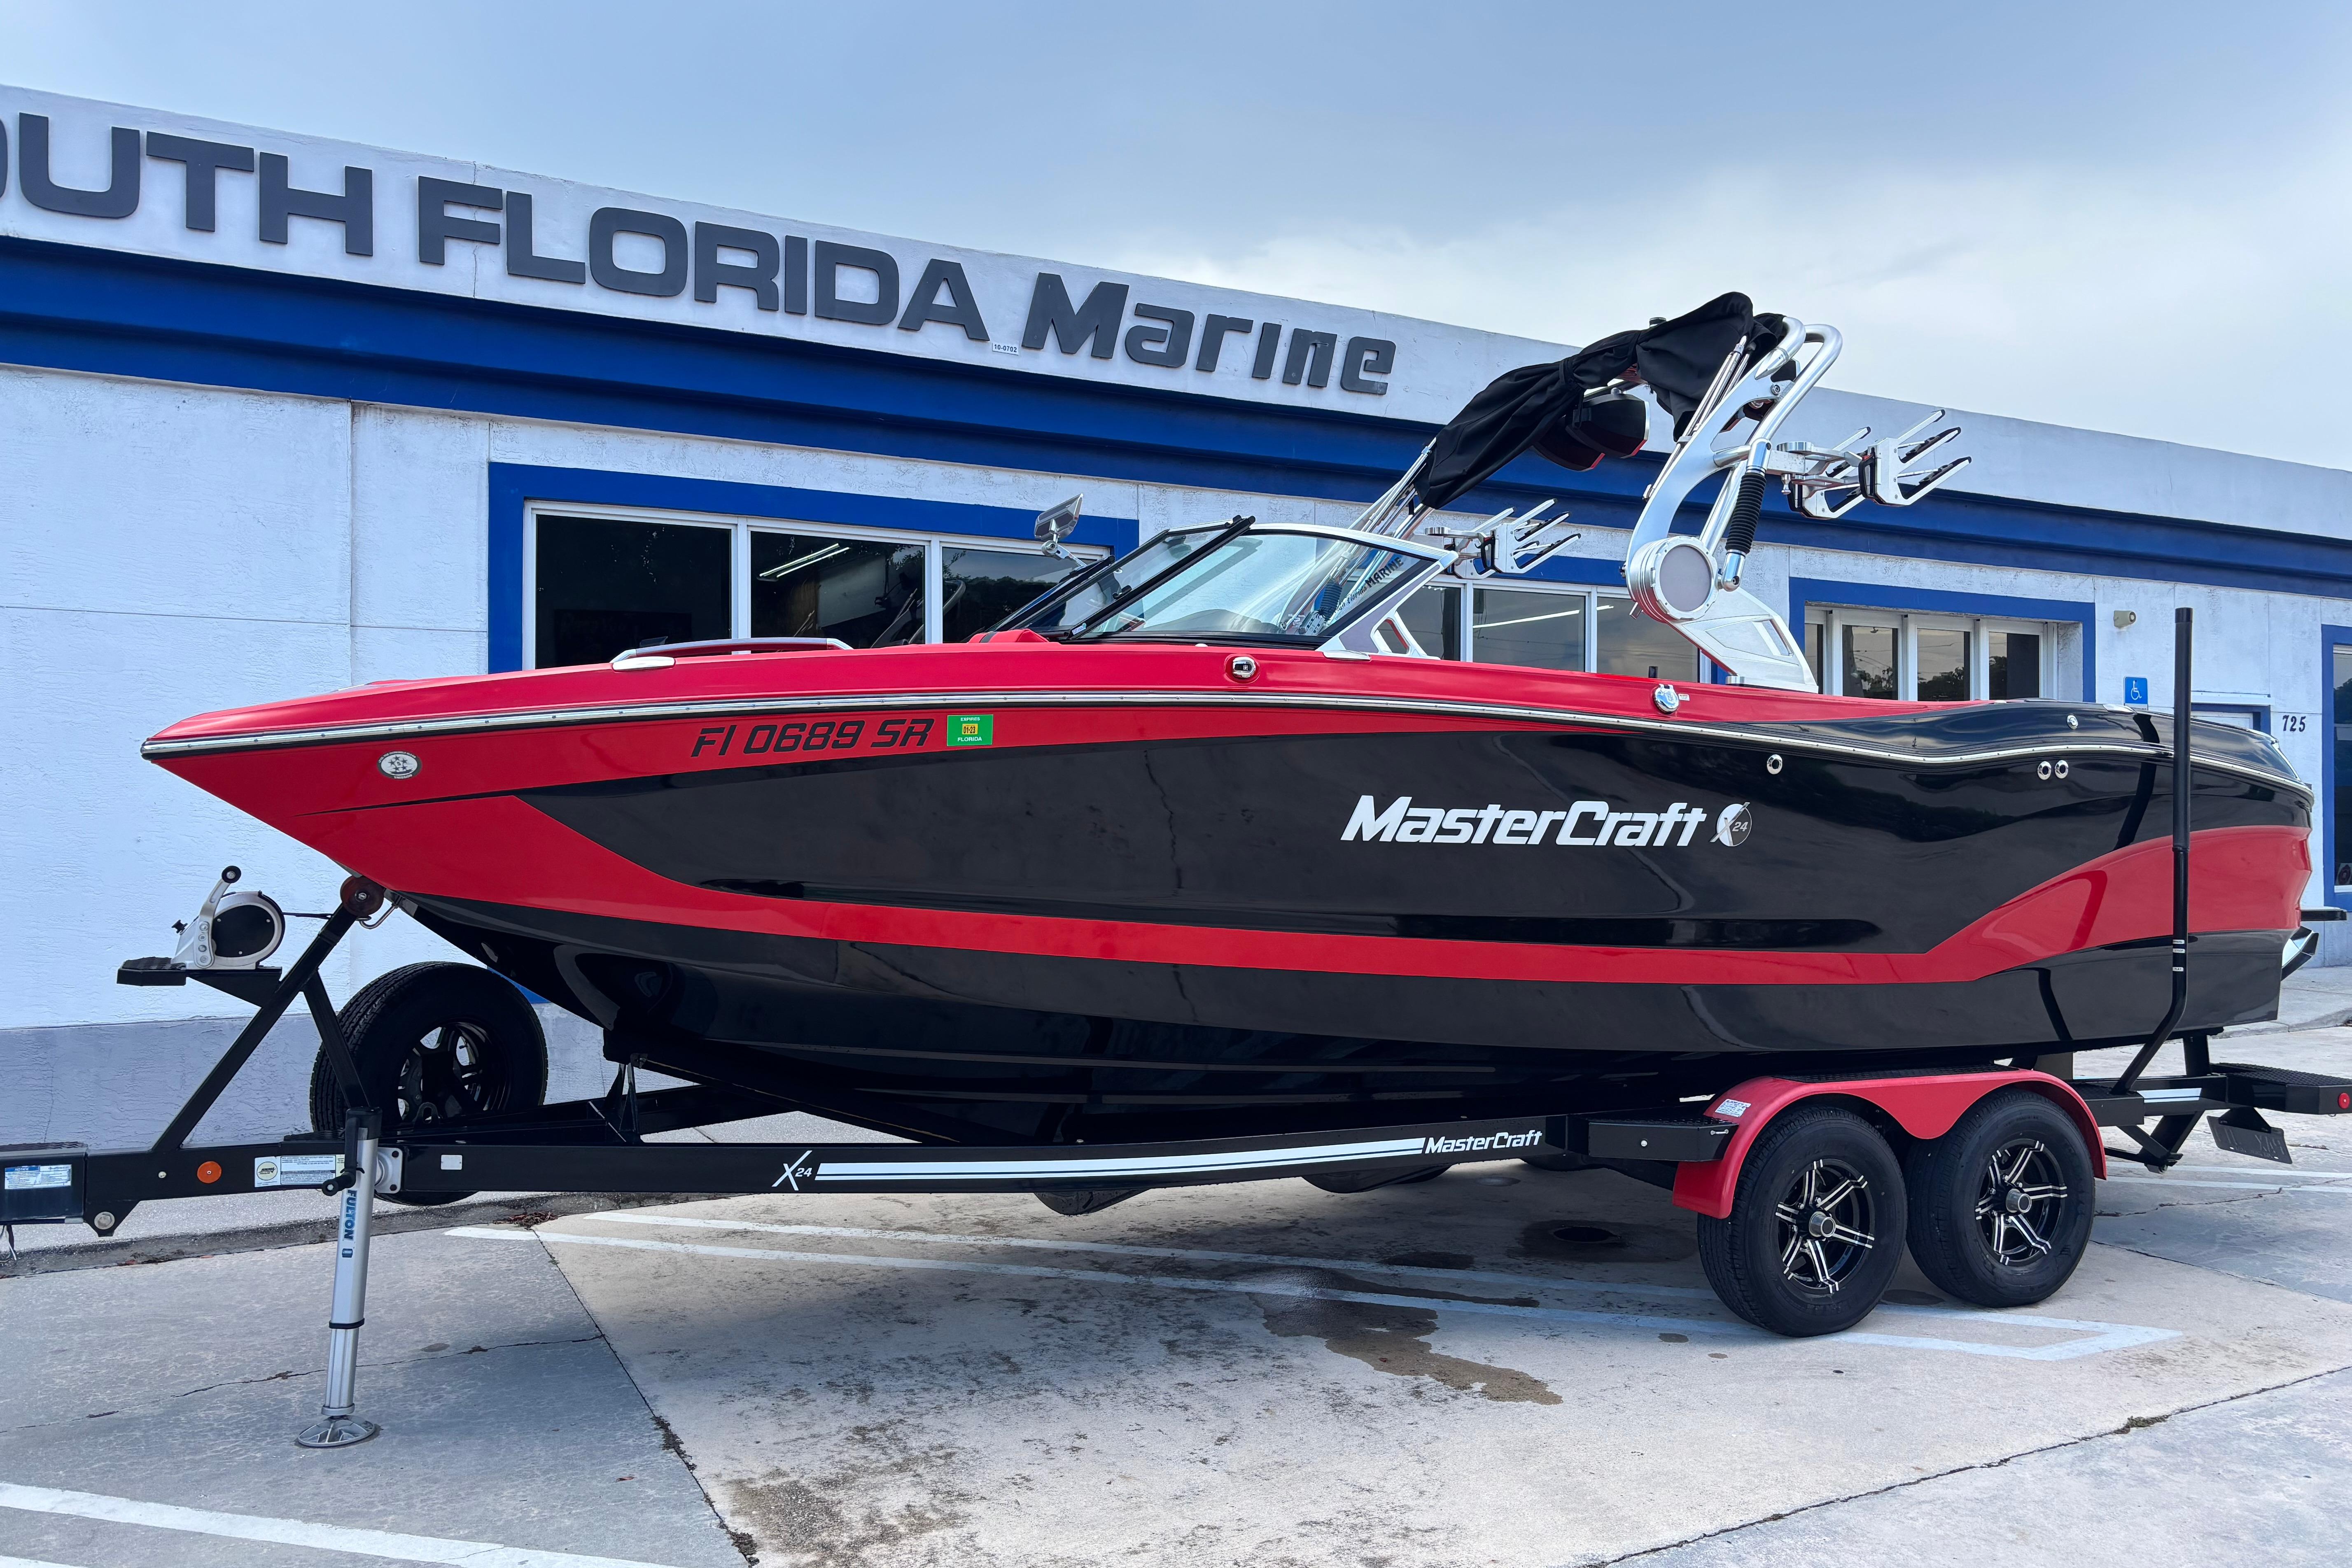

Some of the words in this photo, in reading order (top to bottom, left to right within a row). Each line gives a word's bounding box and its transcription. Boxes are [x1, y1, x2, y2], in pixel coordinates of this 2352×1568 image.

[0, 112, 373, 256] UTH
[418, 175, 990, 341] FLORIDA
[1021, 272, 1396, 395] Marine
[994, 344, 1017, 352] 10-0702
[1365, 557, 1404, 588] MARINE
[743, 720, 865, 754] 0689
[870, 719, 934, 748] SR
[2282, 715, 2306, 732] 725
[1340, 795, 1707, 846] MasterCraft
[1425, 1129, 1542, 1154] MasterCraft
[344, 1190, 357, 1239] FULTON
